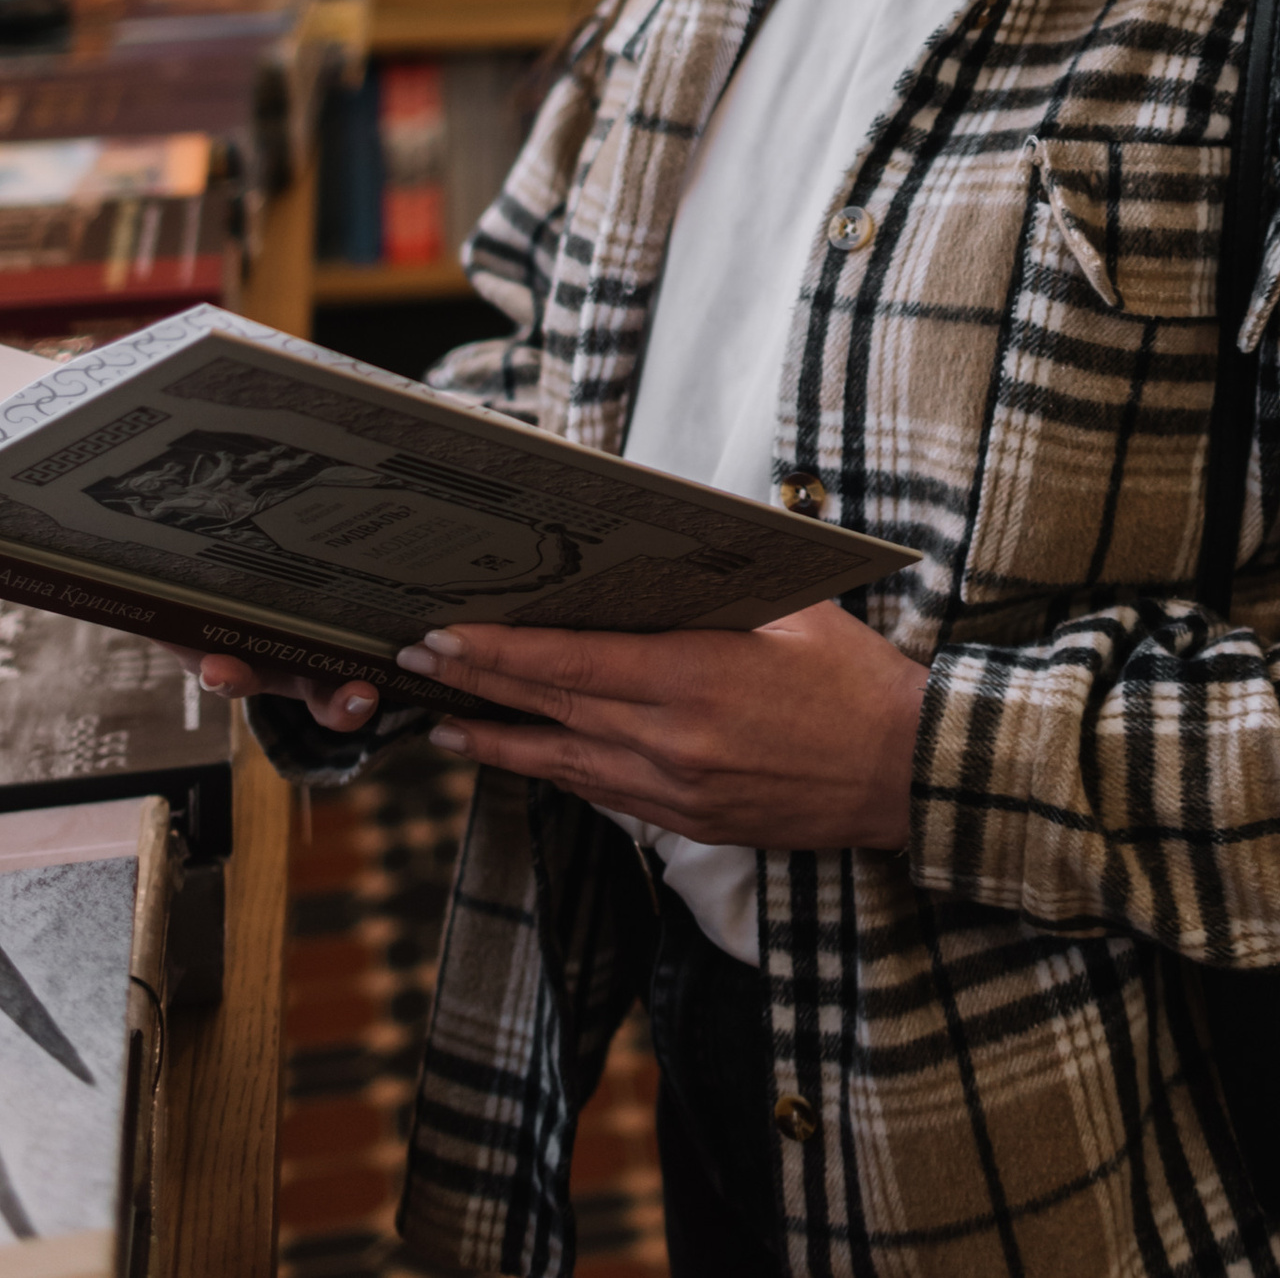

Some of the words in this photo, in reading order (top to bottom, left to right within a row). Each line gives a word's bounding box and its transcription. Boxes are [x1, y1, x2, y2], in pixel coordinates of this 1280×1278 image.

[324, 504, 418, 548] ЛИДВАЛЬ?
[361, 516, 457, 560] МОДЕРН
[0, 568, 53, 597] Анна
[58, 583, 157, 623] Крицкая
[202, 624, 241, 646] ЧТО
[241, 635, 307, 664] ХОТЕЛ
[307, 653, 389, 685] СКАЗАТЬ
